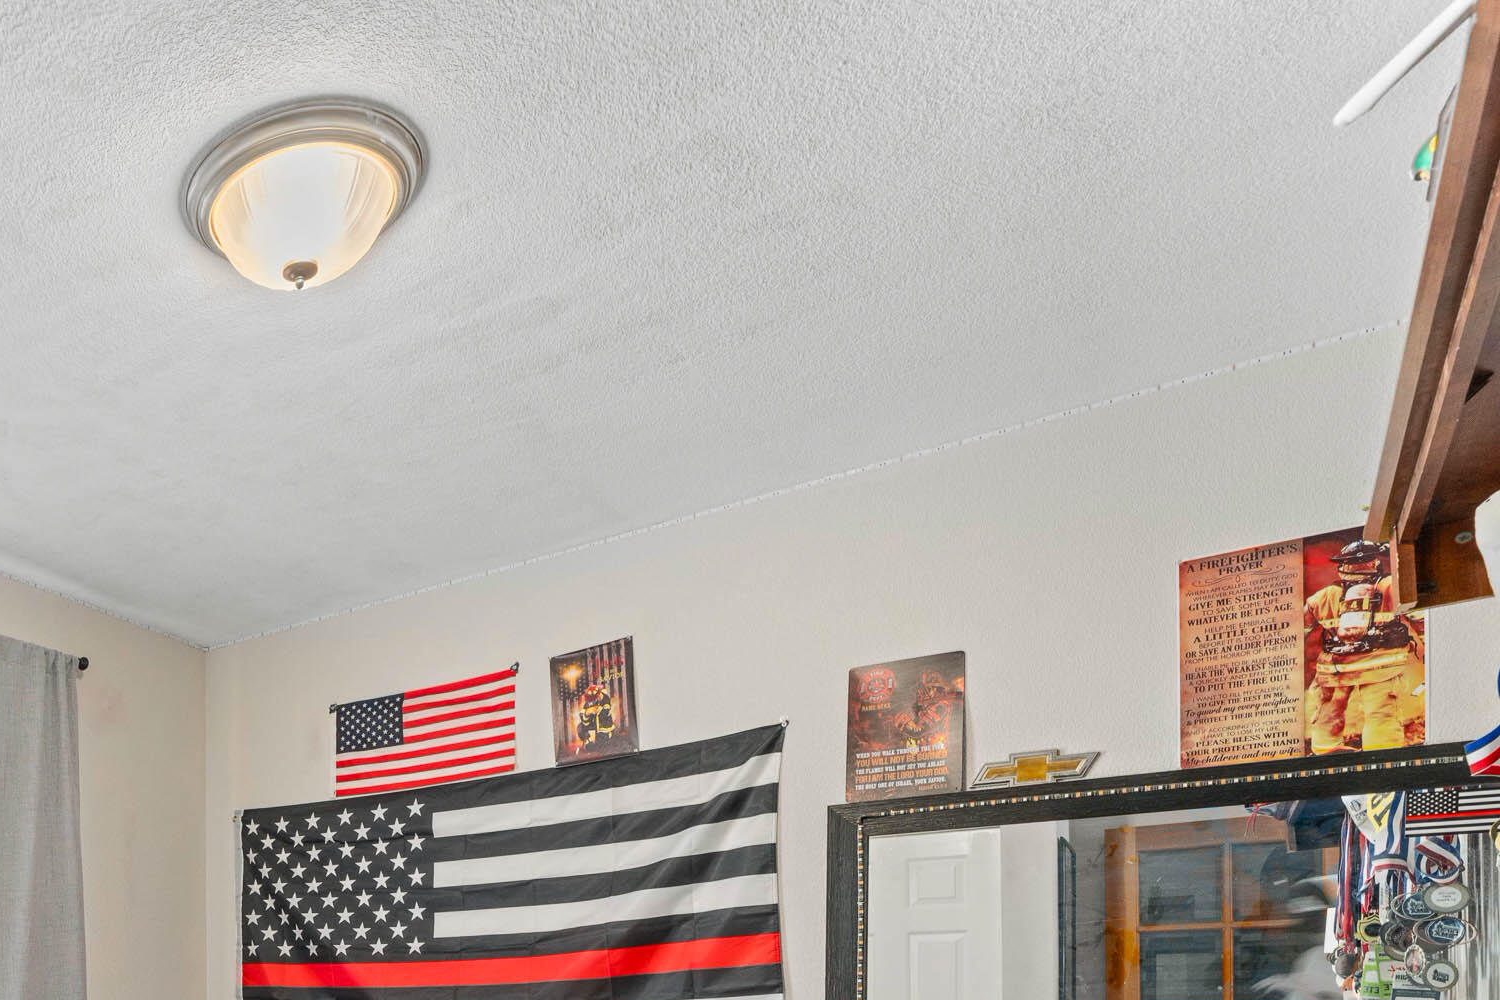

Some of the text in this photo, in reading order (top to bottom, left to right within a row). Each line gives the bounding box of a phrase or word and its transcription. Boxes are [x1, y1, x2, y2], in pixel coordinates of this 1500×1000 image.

[1187, 544, 1297, 573] A FIREFIGHTER'S
[1219, 561, 1263, 575] PRAYER
[1188, 586, 1293, 611] GIVE ME STRENGTH
[1187, 613, 1237, 627] WHATEVER
[1240, 611, 1252, 619] BE
[1206, 629, 1247, 641] LITTLE
[1252, 622, 1290, 634] CHILD
[1185, 635, 1297, 659] OR SAVE AN OLDER PERSON
[1185, 671, 1207, 680] HEAR
[1209, 669, 1225, 677] THE
[1227, 662, 1268, 674] WEAKEST
[1194, 685, 1206, 694] TO
[1208, 682, 1225, 691] PUT
[1228, 680, 1245, 688] THE
[1247, 677, 1268, 685] FIRE
[1186, 738, 1300, 757] YOUR PROTECTING HAND
[1196, 731, 1288, 748] PLEASE BLESS WITH
